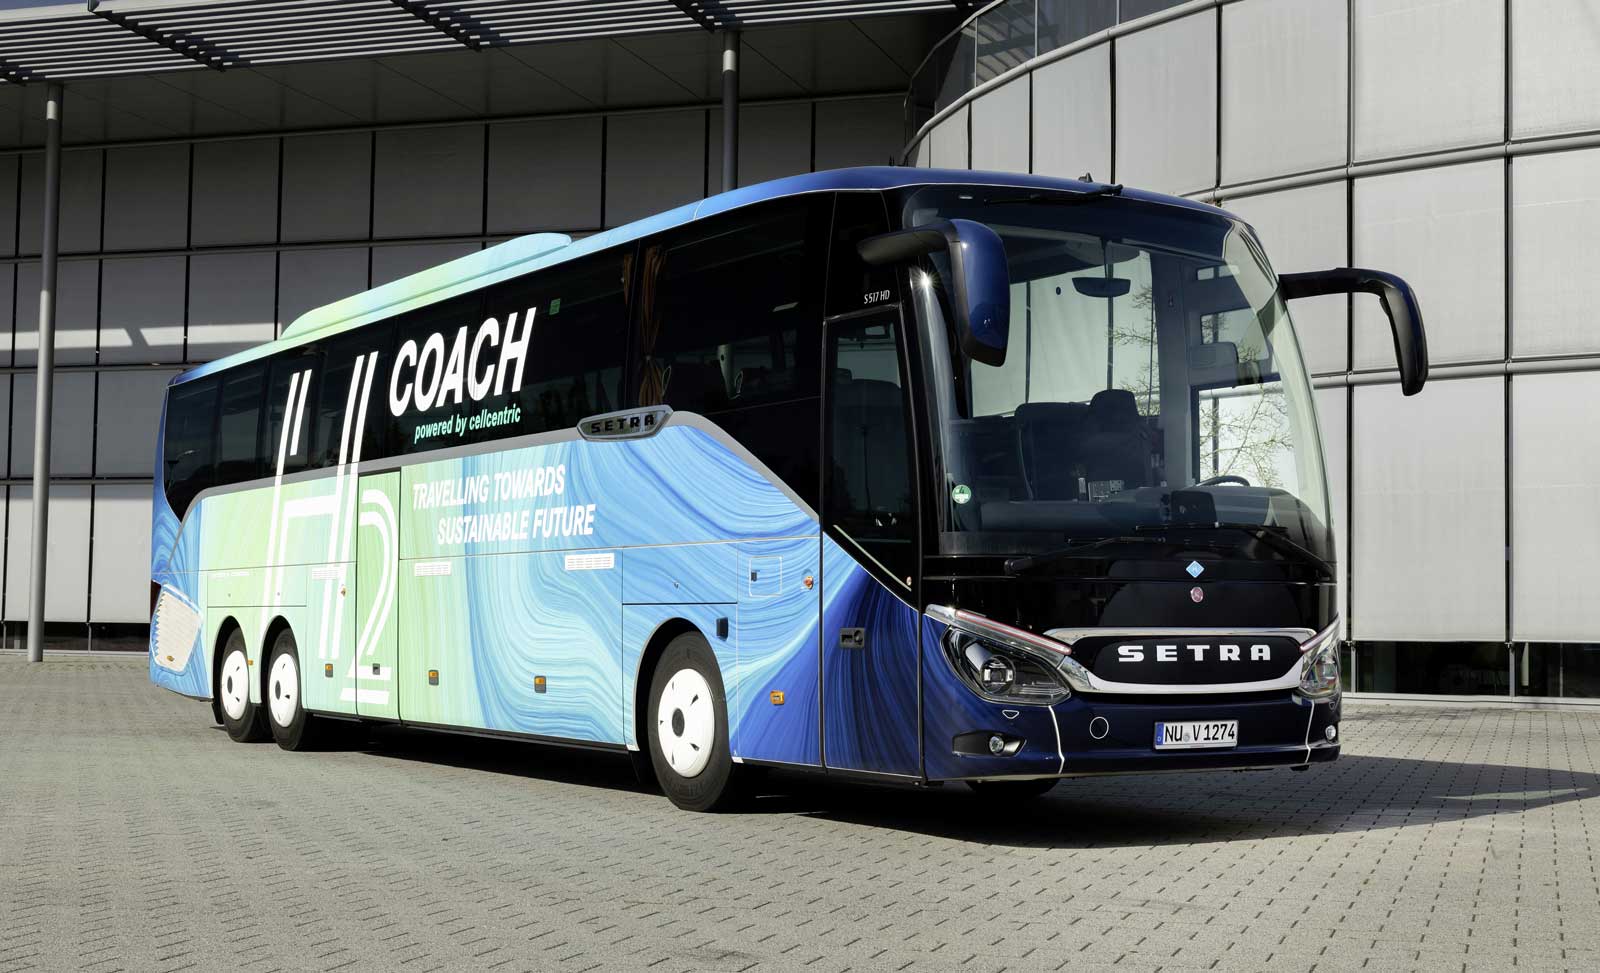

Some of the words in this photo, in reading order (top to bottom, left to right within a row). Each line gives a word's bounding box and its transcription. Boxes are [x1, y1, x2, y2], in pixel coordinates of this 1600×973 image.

[869, 291, 879, 303] 517
[880, 289, 890, 301] HD
[389, 307, 536, 417] COACH
[414, 415, 453, 444] powered
[455, 414, 467, 437] by
[469, 403, 521, 430] cellcentric
[591, 414, 655, 433] SETRA
[413, 476, 490, 510] TRAVELLING
[493, 464, 566, 501] TOWARDS
[437, 512, 529, 545] SUSTAINABLE
[533, 504, 596, 538] FUTURE
[1117, 644, 1271, 662] SETRA
[1165, 725, 1183, 742] NU
[1193, 724, 1201, 741] V
[1203, 723, 1235, 741] 1274
